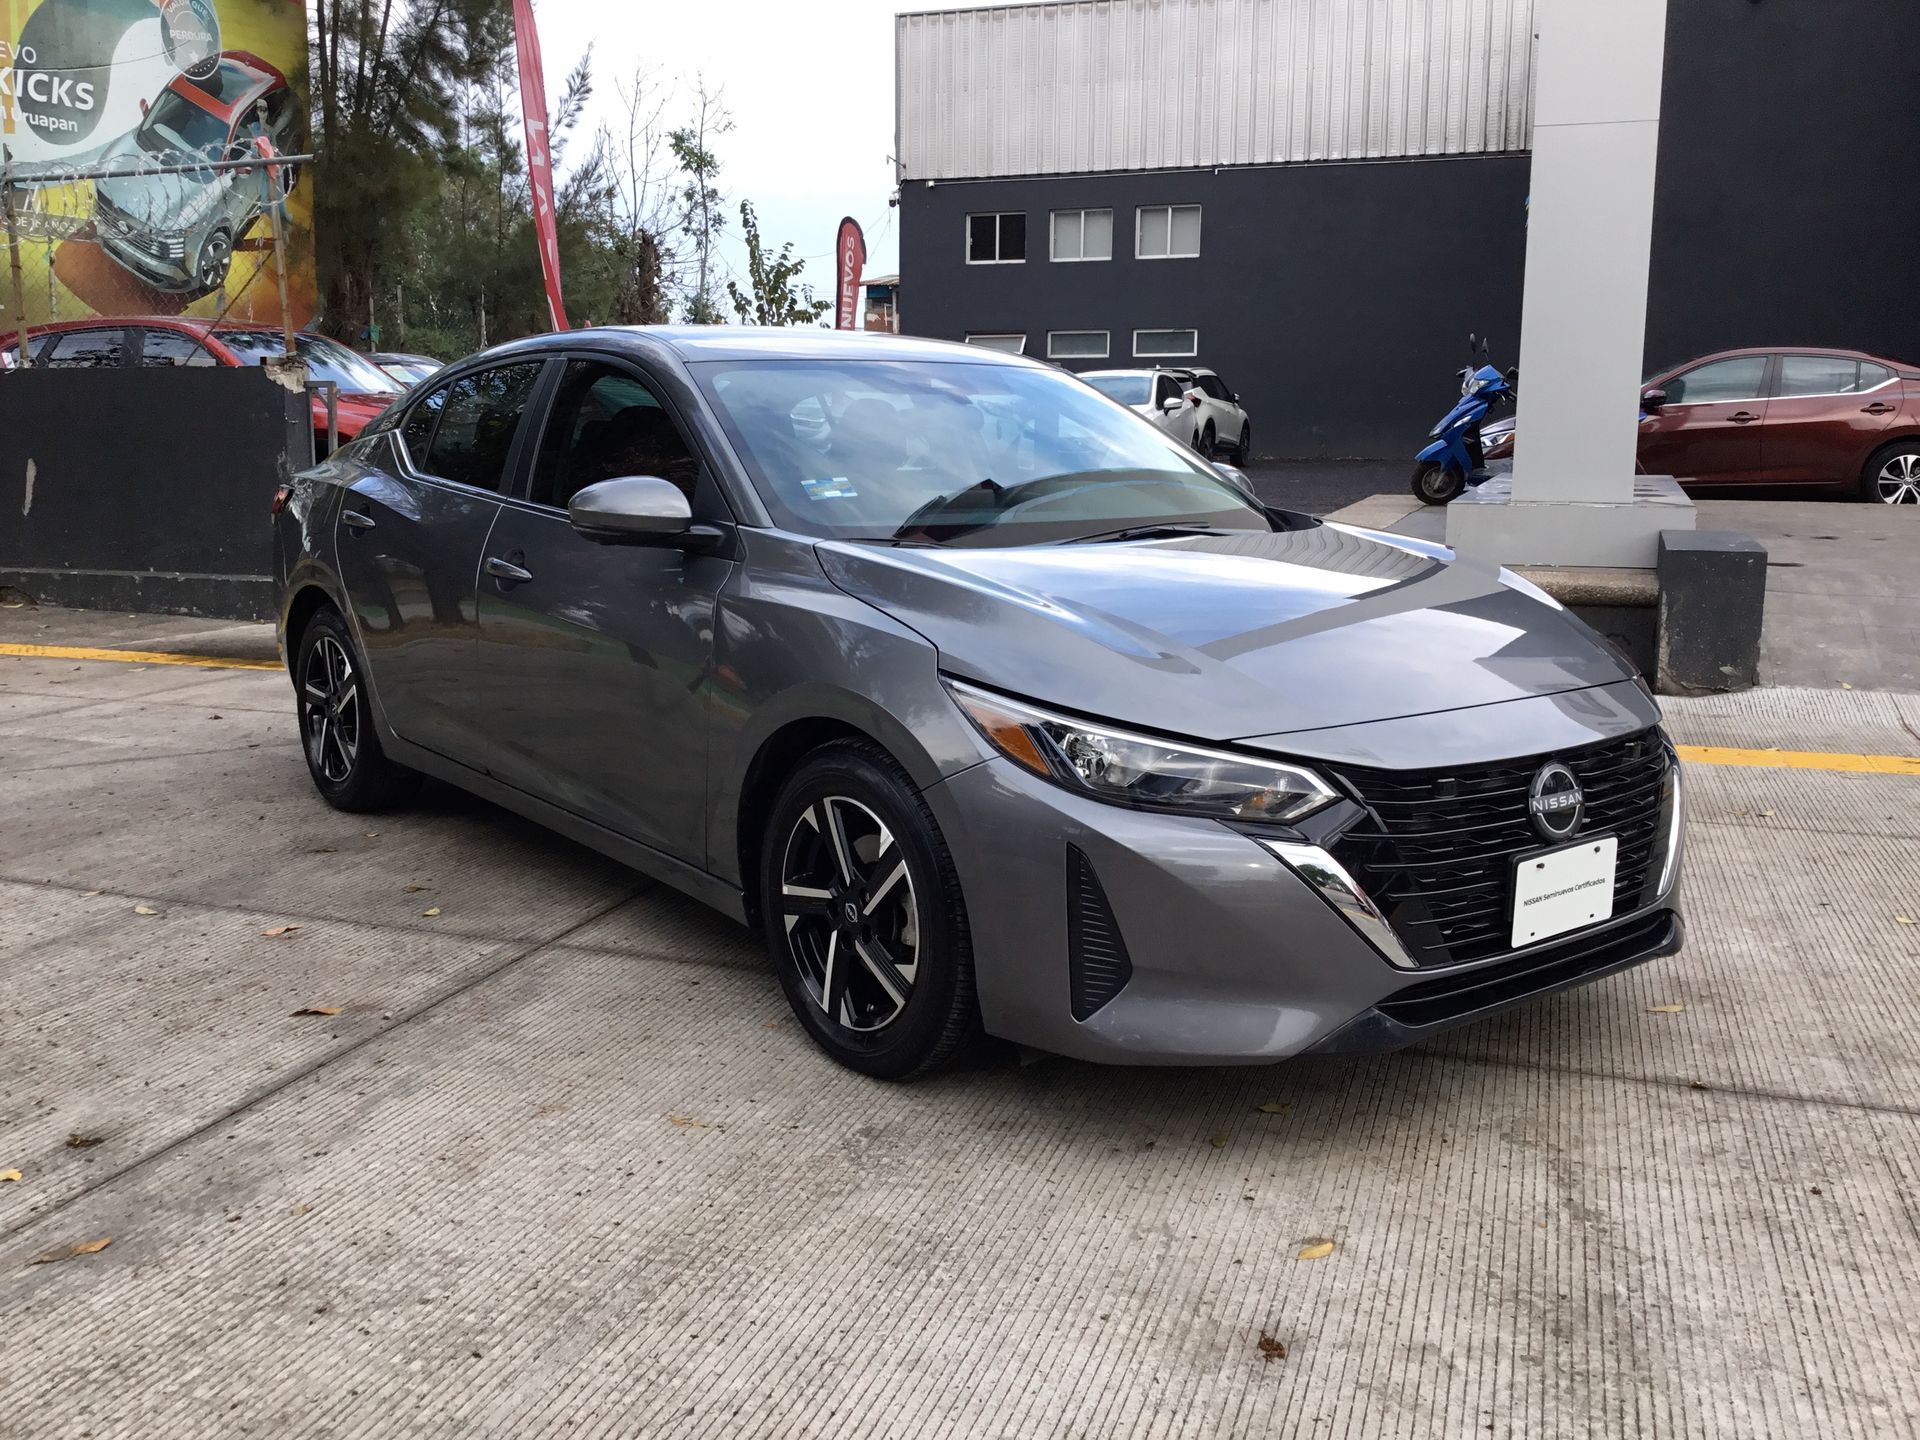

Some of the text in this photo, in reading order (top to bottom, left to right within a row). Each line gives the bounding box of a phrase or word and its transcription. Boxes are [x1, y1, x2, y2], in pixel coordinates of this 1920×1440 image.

[169, 29, 214, 42] PERDURA
[841, 236, 855, 328] NUEVOS
[1533, 792, 1582, 811] NISSAN
[1524, 878, 1605, 906] NISSAN Seminuevos Certificados
